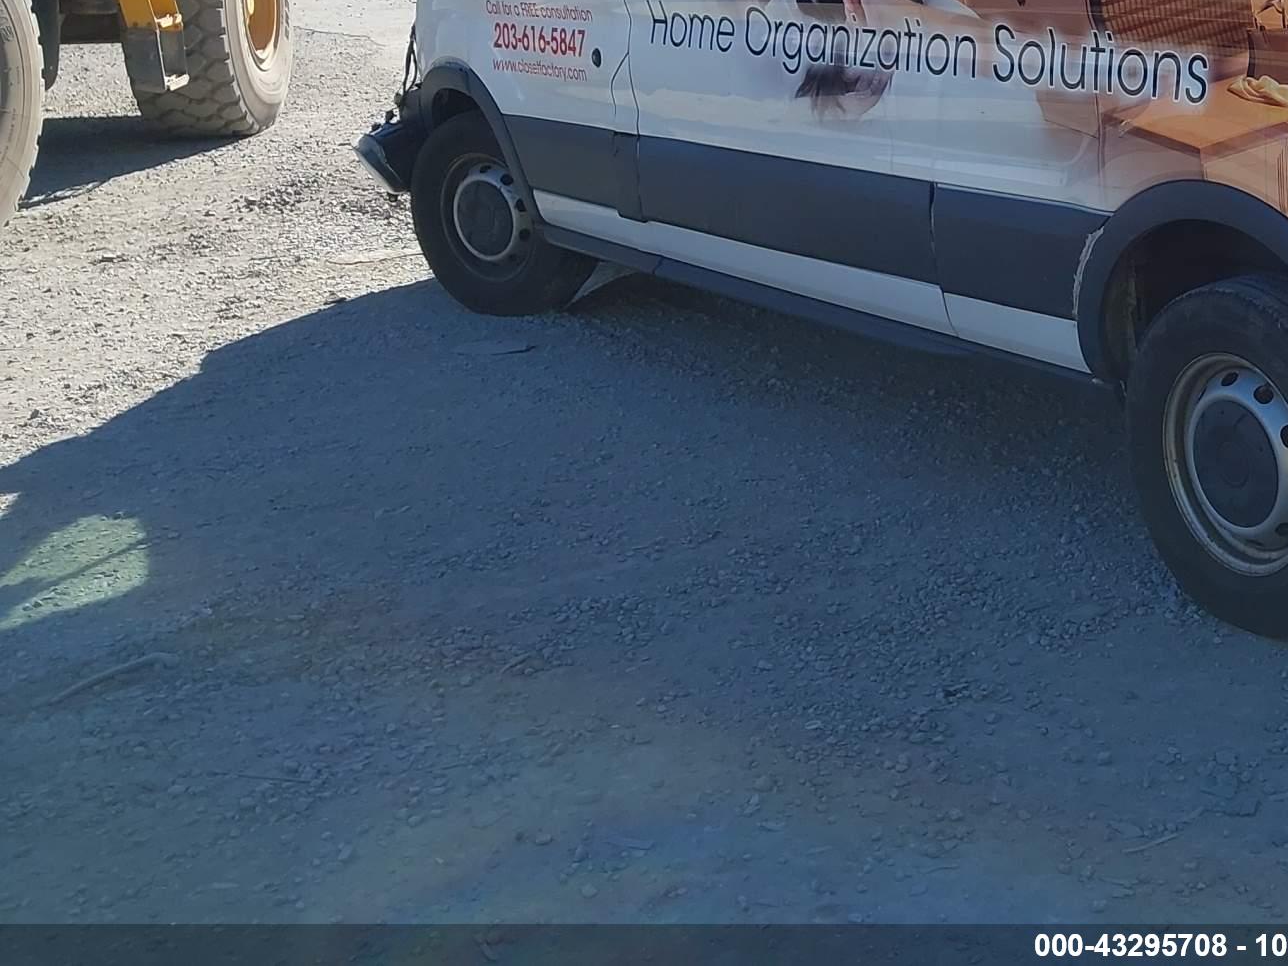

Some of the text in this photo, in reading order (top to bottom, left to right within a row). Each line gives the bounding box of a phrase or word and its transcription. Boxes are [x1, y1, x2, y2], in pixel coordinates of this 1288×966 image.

[486, 0, 592, 22] Call for a FREE consultation
[494, 22, 586, 57] 203-616-5847
[646, 0, 1209, 104] Home Organization Solutions
[493, 58, 587, 82] www.closetfactory.com
